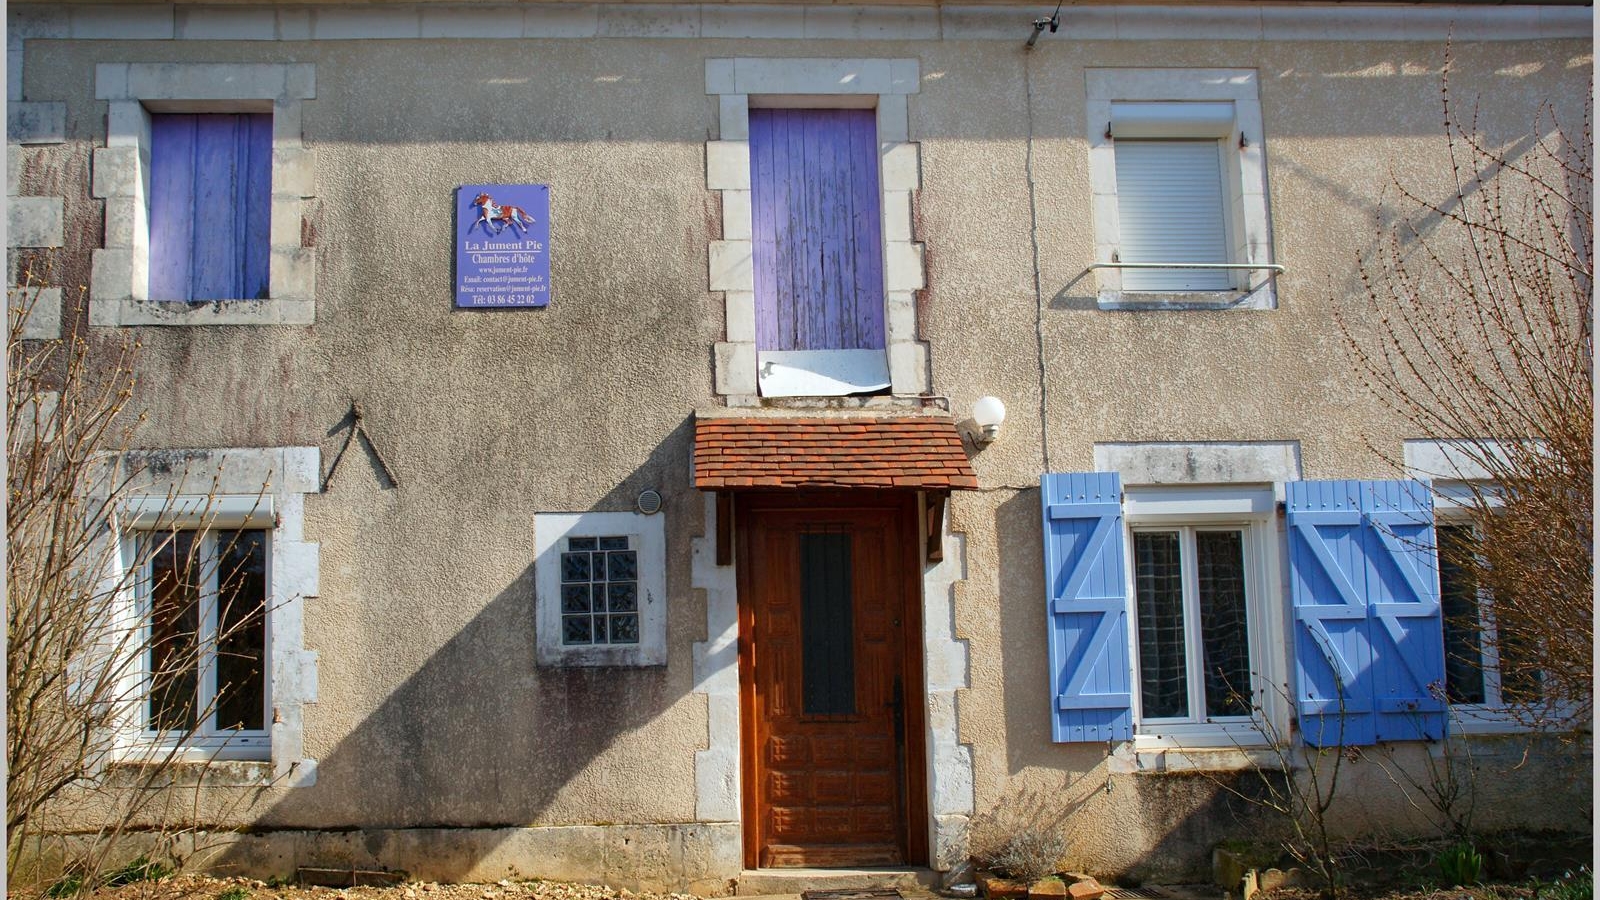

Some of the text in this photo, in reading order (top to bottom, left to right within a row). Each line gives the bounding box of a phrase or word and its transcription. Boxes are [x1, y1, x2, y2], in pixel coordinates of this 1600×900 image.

[465, 240, 543, 250] La Jument Pie
[472, 253, 535, 264] Chambres d'hôte
[479, 266, 528, 274] www.jument-pie.fr
[464, 275, 543, 284] Email: contact@jument-pie.fr
[472, 294, 535, 304] Tél: 03 86 45 22 02
